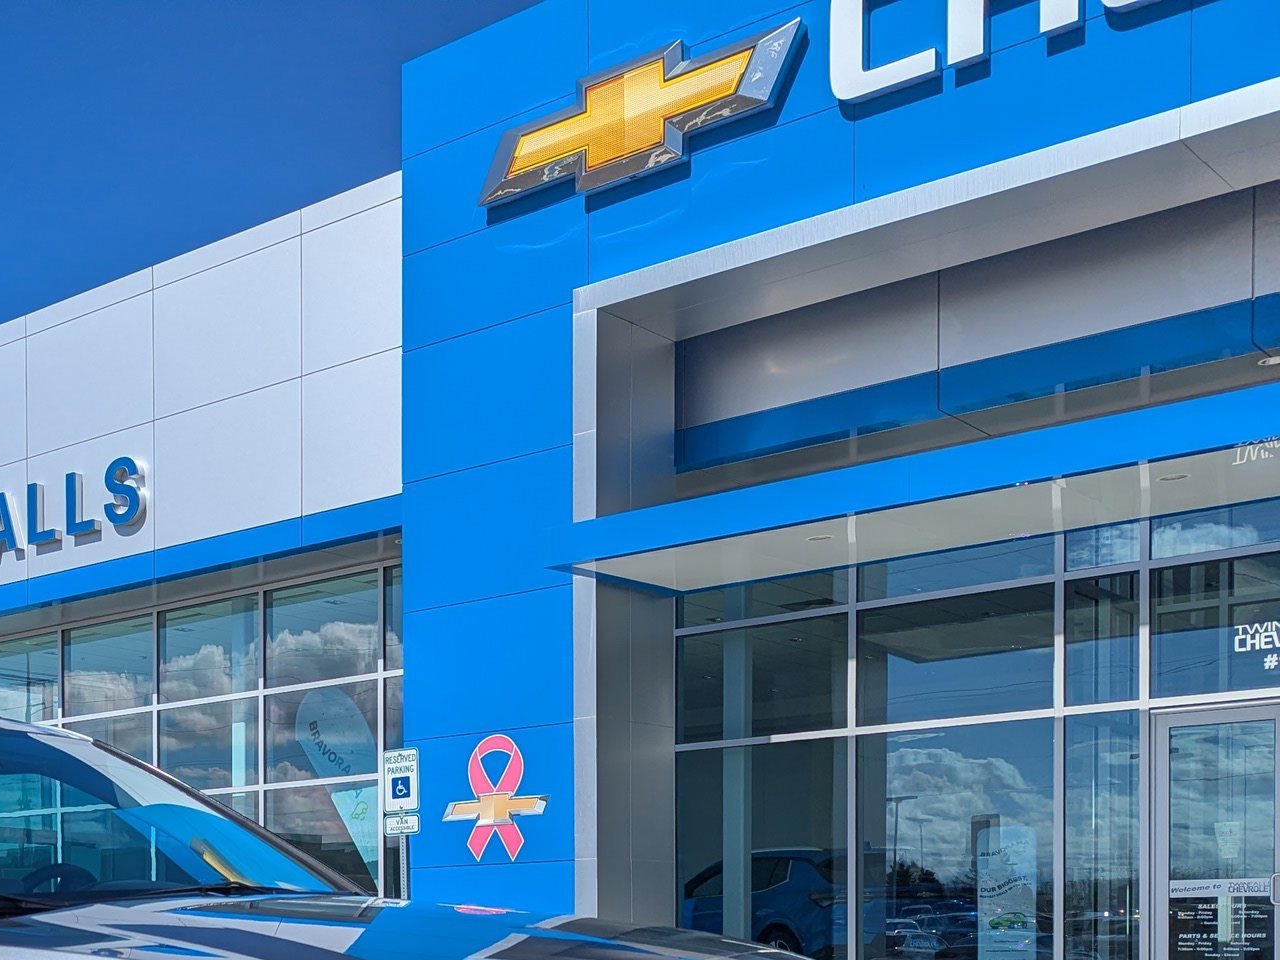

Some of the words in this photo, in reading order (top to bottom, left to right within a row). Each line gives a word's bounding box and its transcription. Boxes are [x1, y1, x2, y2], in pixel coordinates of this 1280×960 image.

[385, 753, 416, 765] RESERVED
[387, 765, 414, 775] PARKING
[396, 818, 409, 826] VAN
[1171, 885, 1210, 894] Welcome
